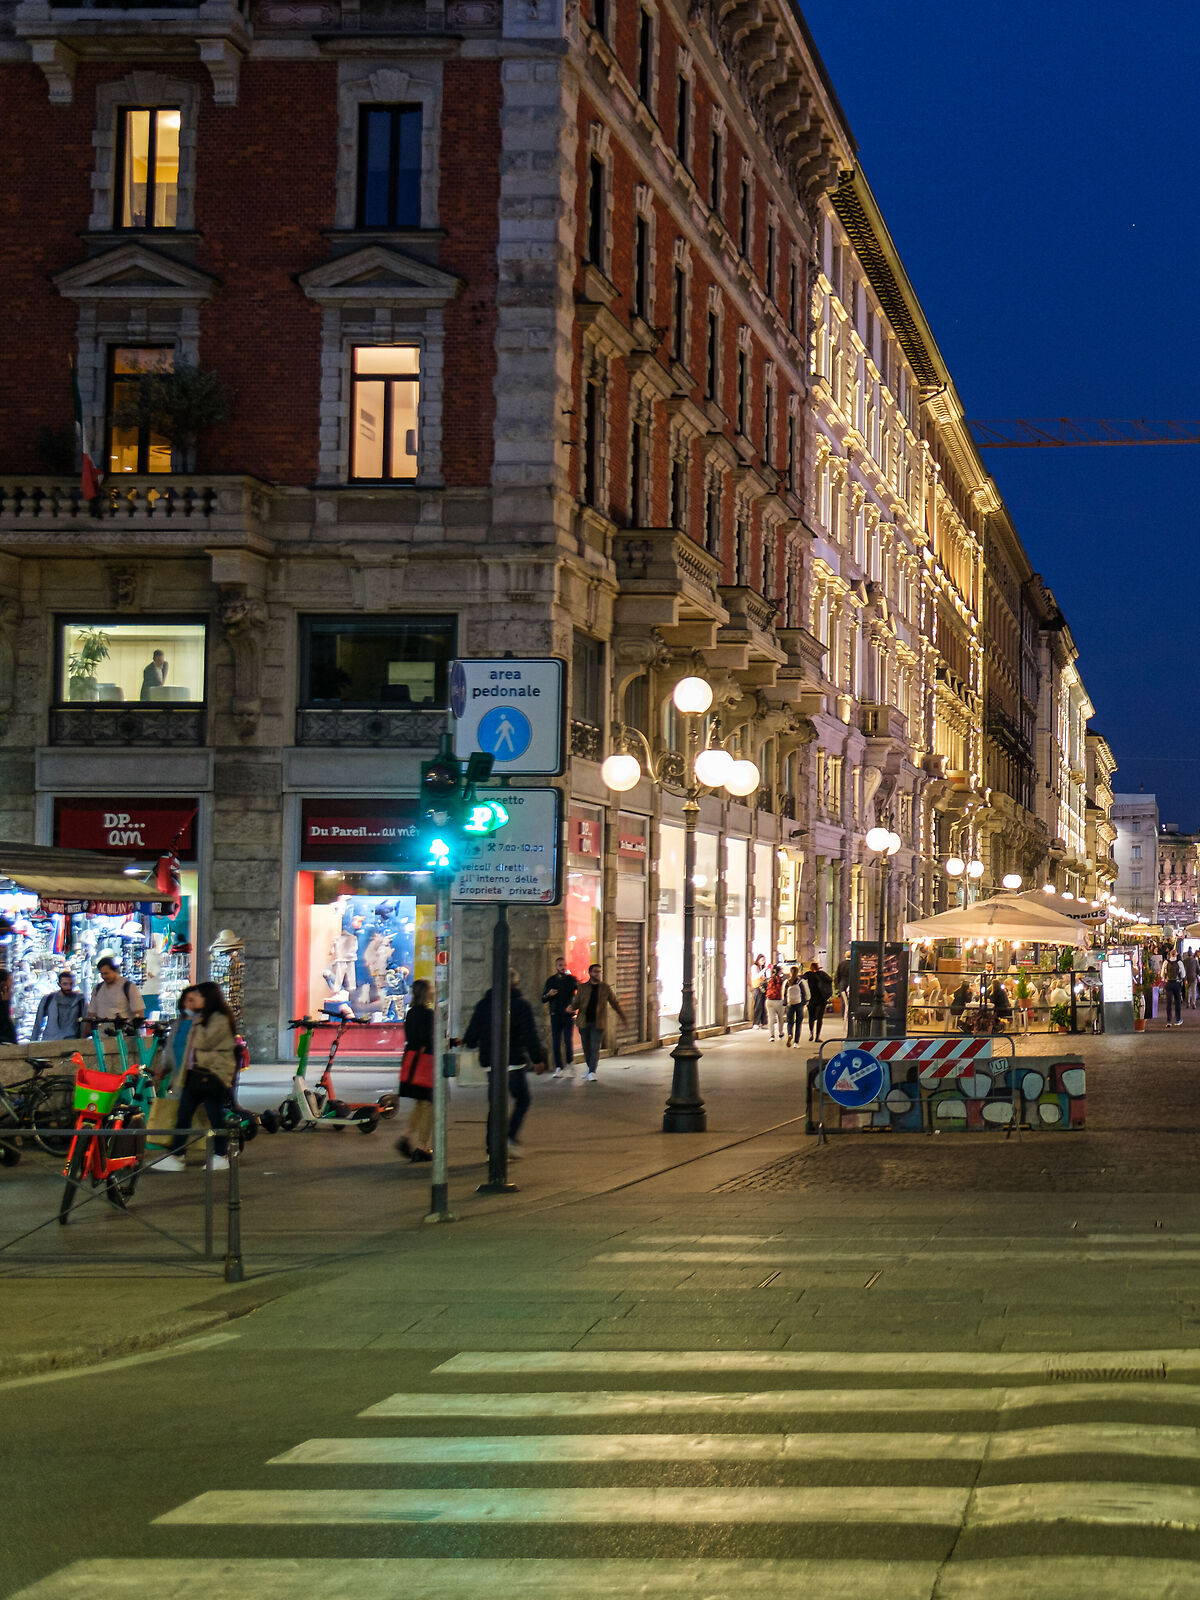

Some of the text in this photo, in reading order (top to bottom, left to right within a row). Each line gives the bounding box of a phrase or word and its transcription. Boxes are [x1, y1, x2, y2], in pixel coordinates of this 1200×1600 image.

[489, 670, 522, 680] area
[472, 685, 541, 699] pedonale
[103, 813, 146, 828] DP...
[310, 826, 329, 837] Du
[331, 826, 381, 837] Pareil...
[382, 827, 396, 837] au
[108, 829, 146, 846] am
[514, 875, 539, 884] delle
[1060, 910, 1106, 920] onald's
